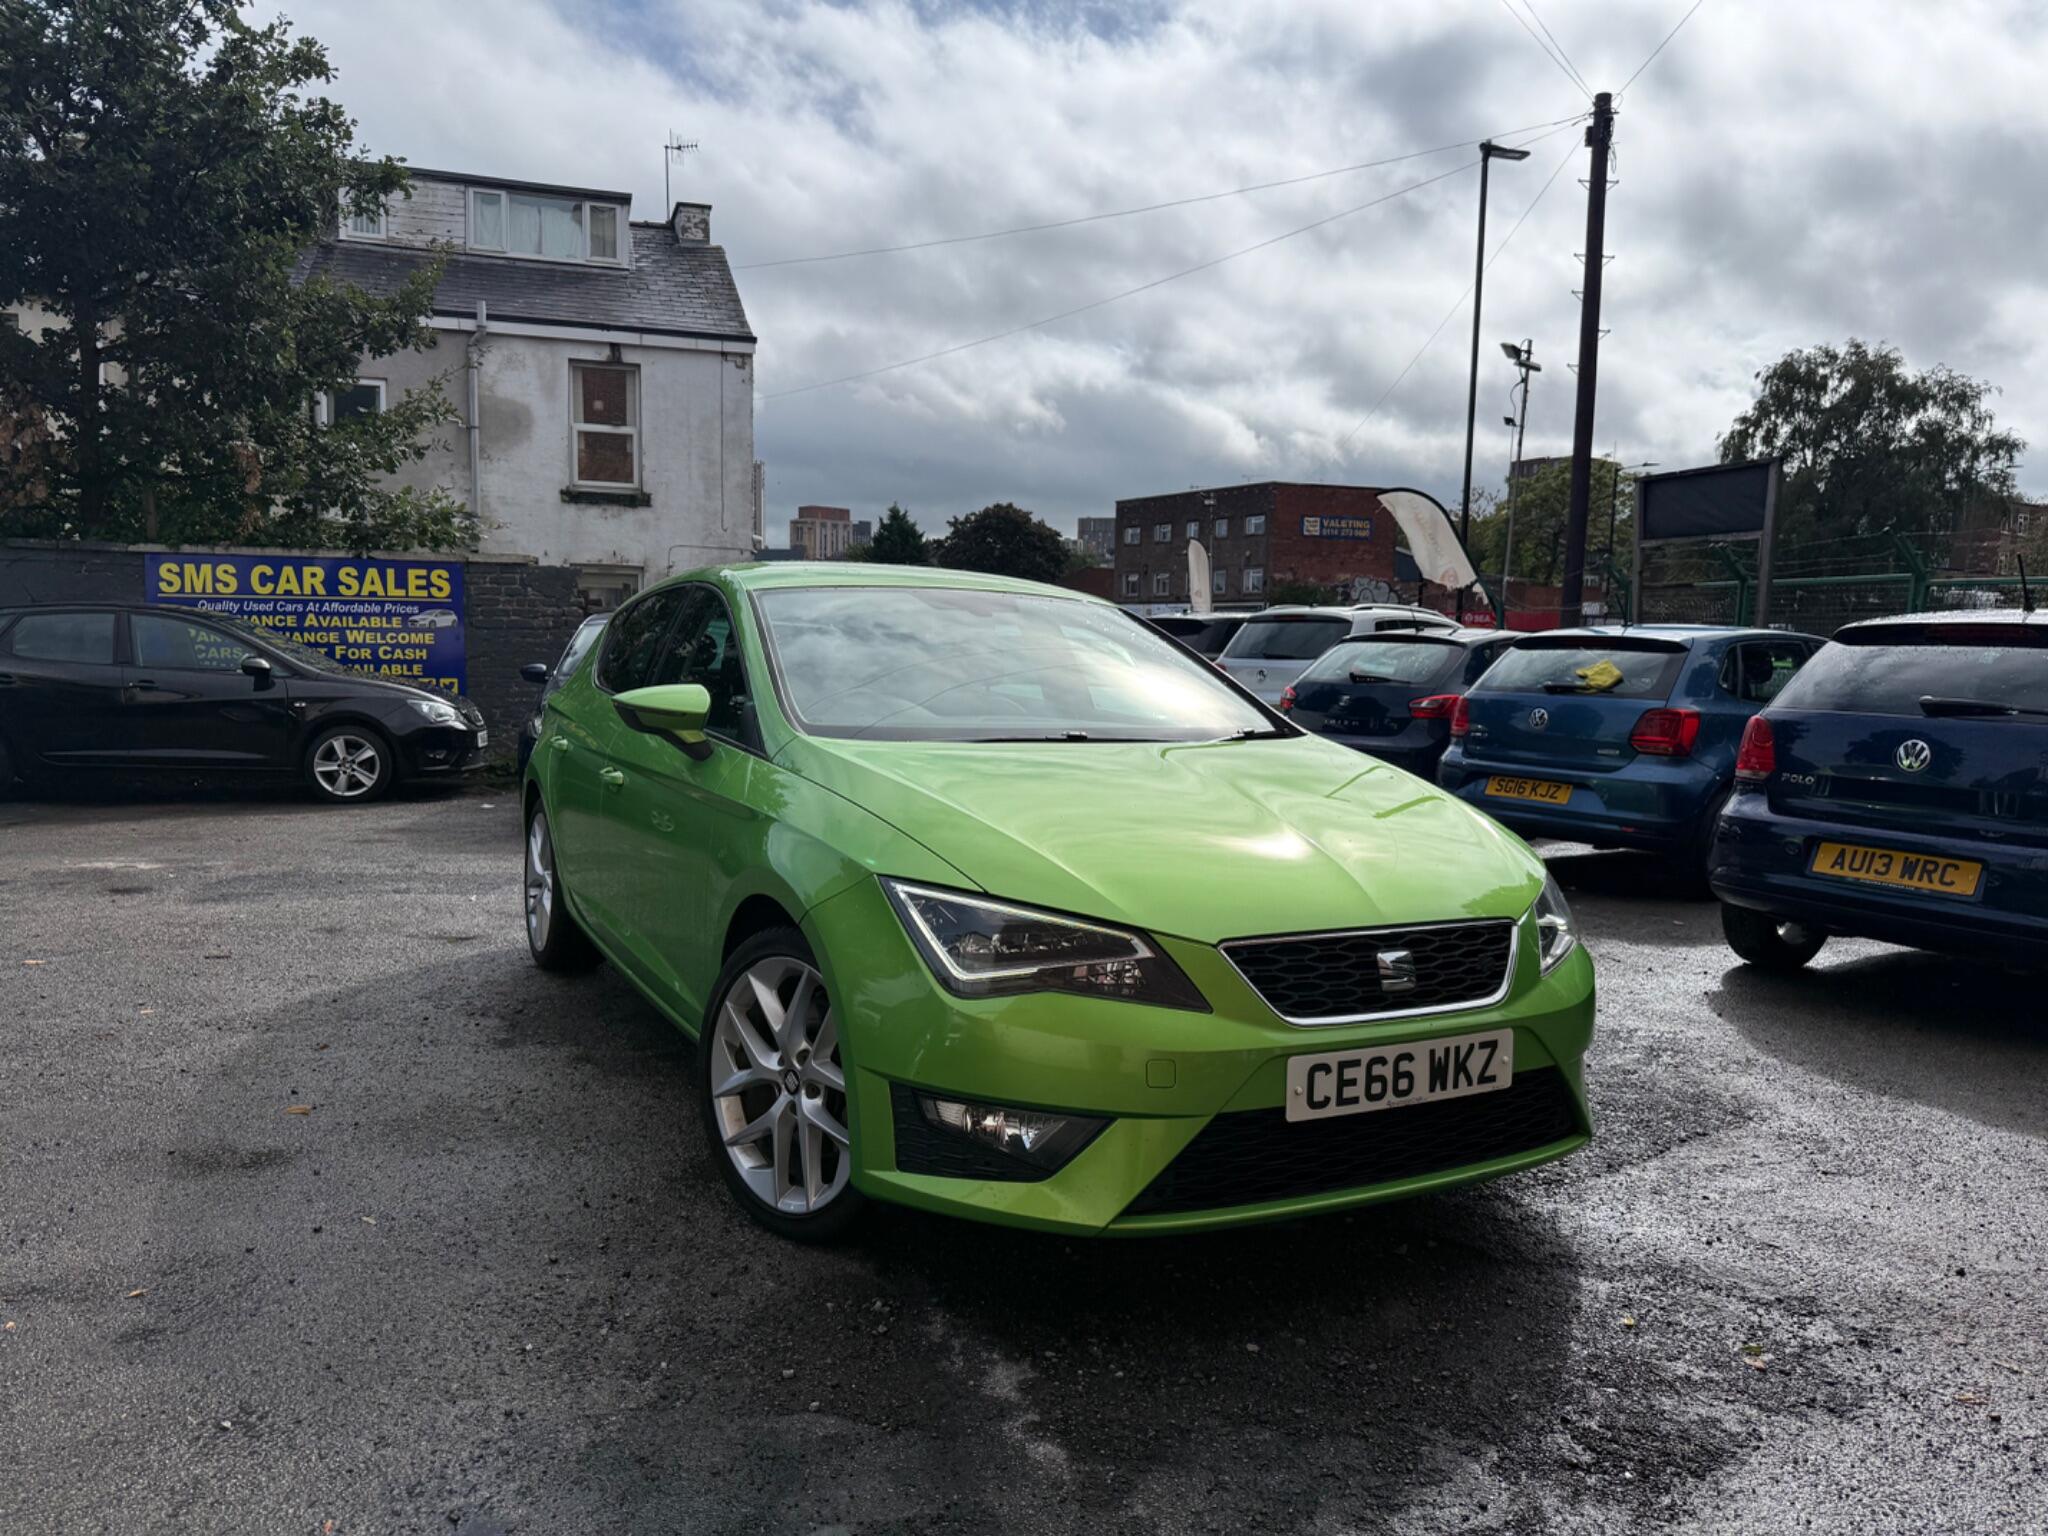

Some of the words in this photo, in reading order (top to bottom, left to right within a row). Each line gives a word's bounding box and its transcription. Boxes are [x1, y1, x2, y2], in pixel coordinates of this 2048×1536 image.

[1323, 519, 1370, 529] VALETING
[158, 562, 238, 594] SMS
[250, 564, 325, 595] CAR
[338, 567, 452, 598] SALES
[197, 600, 240, 613] Quality
[243, 601, 274, 612] Used
[276, 602, 303, 612] Cars
[306, 603, 319, 612] At
[321, 602, 381, 614] Affordable
[384, 603, 420, 614] Prices
[303, 613, 402, 628] AVAILABLE
[345, 630, 435, 644] WELCOME
[335, 645, 372, 660] FOR
[378, 645, 427, 660] CASH
[1781, 773, 1815, 785] POLO
[1495, 778, 1527, 796] SG16
[1529, 781, 1562, 800] KJZ
[1830, 848, 1892, 876] AU13
[1898, 856, 1960, 887] WRC
[1306, 1052, 1415, 1110] CE66
[1428, 1039, 1498, 1093] WKZ
